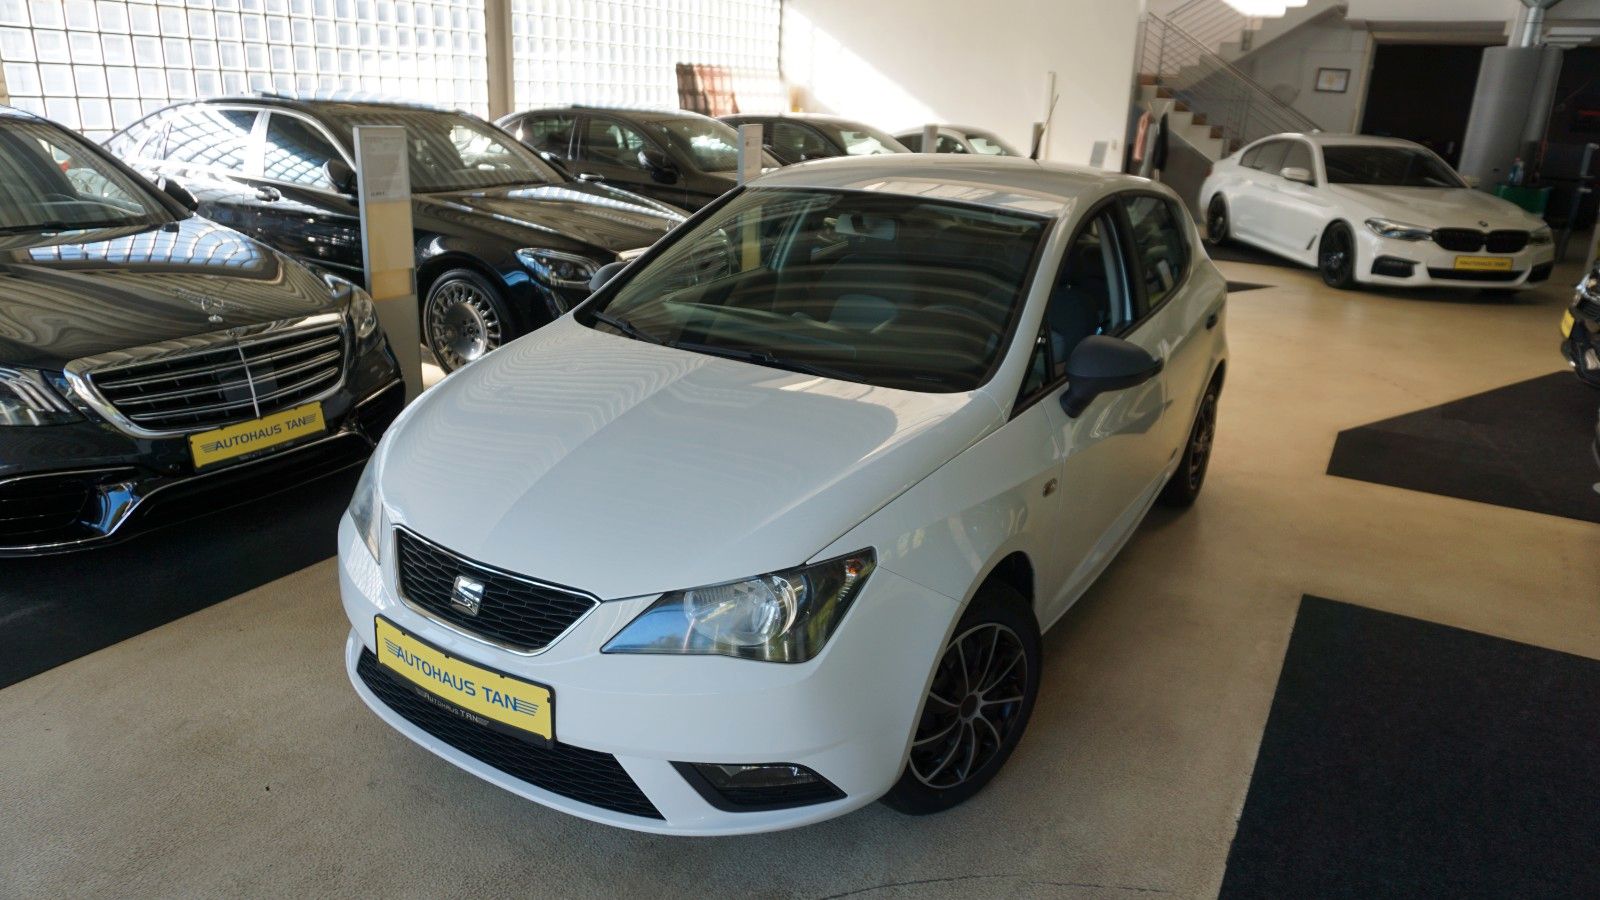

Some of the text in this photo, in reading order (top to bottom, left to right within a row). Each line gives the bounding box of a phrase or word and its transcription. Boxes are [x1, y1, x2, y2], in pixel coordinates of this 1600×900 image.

[215, 416, 306, 450] AUTOHAUS TAN
[397, 646, 518, 712] AUTOHAUS TAN
